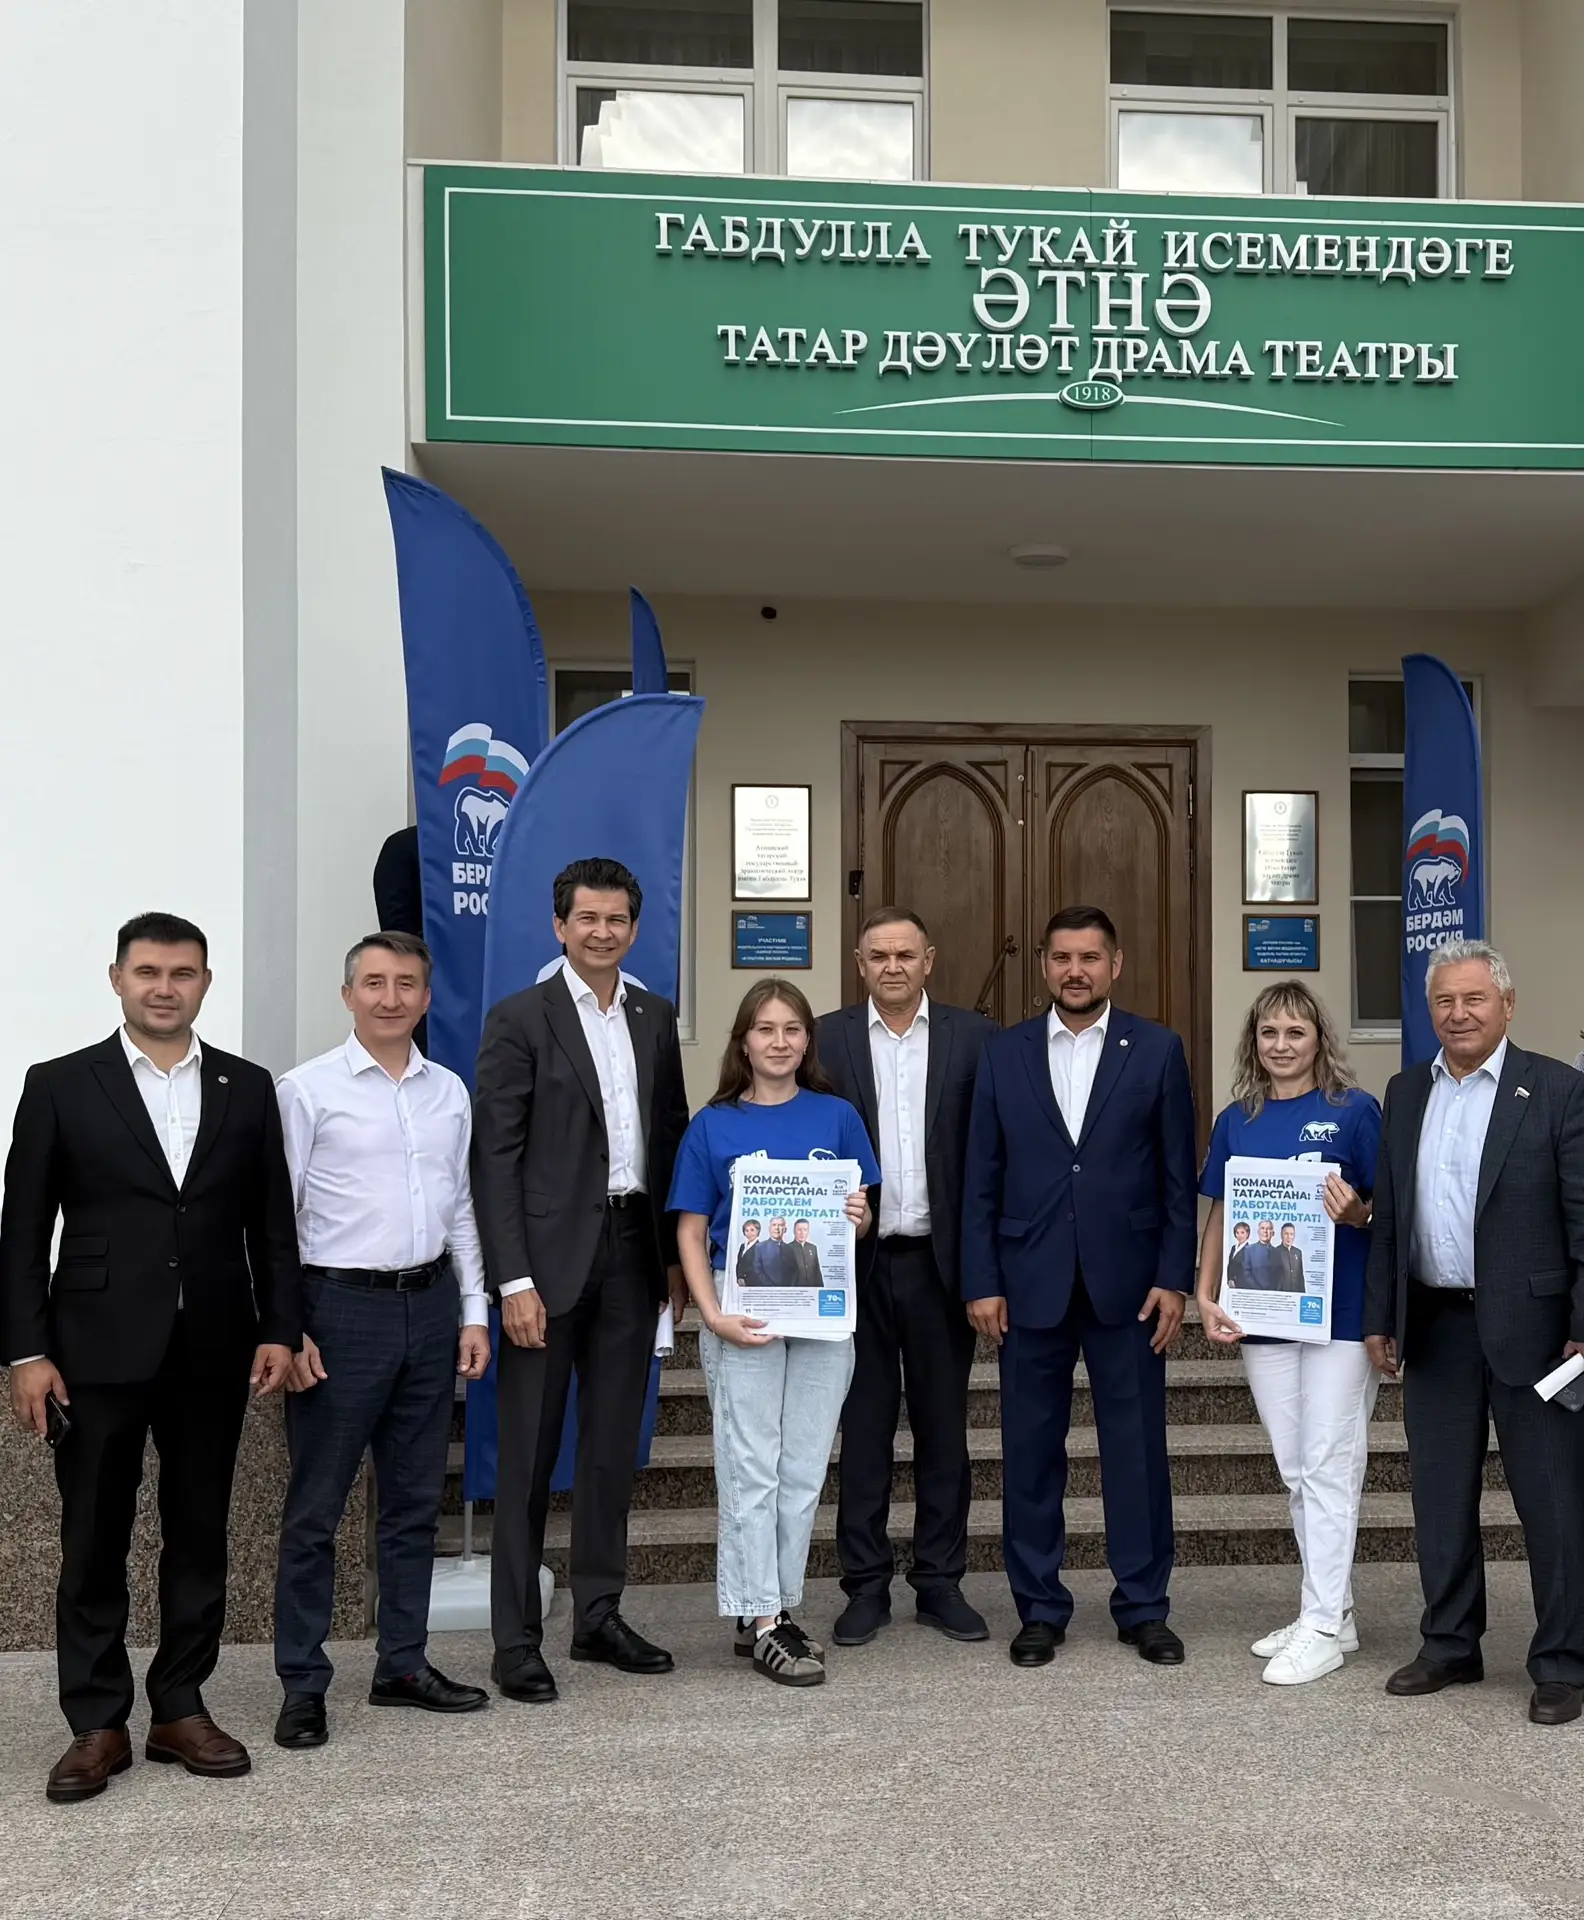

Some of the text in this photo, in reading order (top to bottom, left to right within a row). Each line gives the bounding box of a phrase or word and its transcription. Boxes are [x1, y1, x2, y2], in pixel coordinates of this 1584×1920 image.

[655, 212, 1515, 285] ГАБДУЛЛА ТУКАЙ ИСЕМЕНДӘГЕ
[973, 267, 1212, 337] ӘТНӘ
[717, 325, 1459, 384] ТАТАР ДӘҮЛӘТ ДРАМА ТЕАТРЫ
[1074, 385, 1111, 402] 1918
[452, 862, 492, 887] БЕР
[453, 891, 489, 916] РОС
[1406, 908, 1464, 932] БЕРДӘМ
[743, 1174, 810, 1186] КОМАНДА
[1233, 1177, 1294, 1189] КОМАНДА
[743, 1186, 828, 1196] ТАТАРСТАНА:
[1233, 1188, 1311, 1200] ТАТАРСТАНА:
[742, 1196, 812, 1207] РАБОТАЕМ
[1232, 1199, 1297, 1211] РАБОТАЕМ
[741, 1207, 840, 1218] НА РЕЗУЛЬТАТ!
[1232, 1210, 1321, 1223] НА РЕЗУЛЬТАТ!
